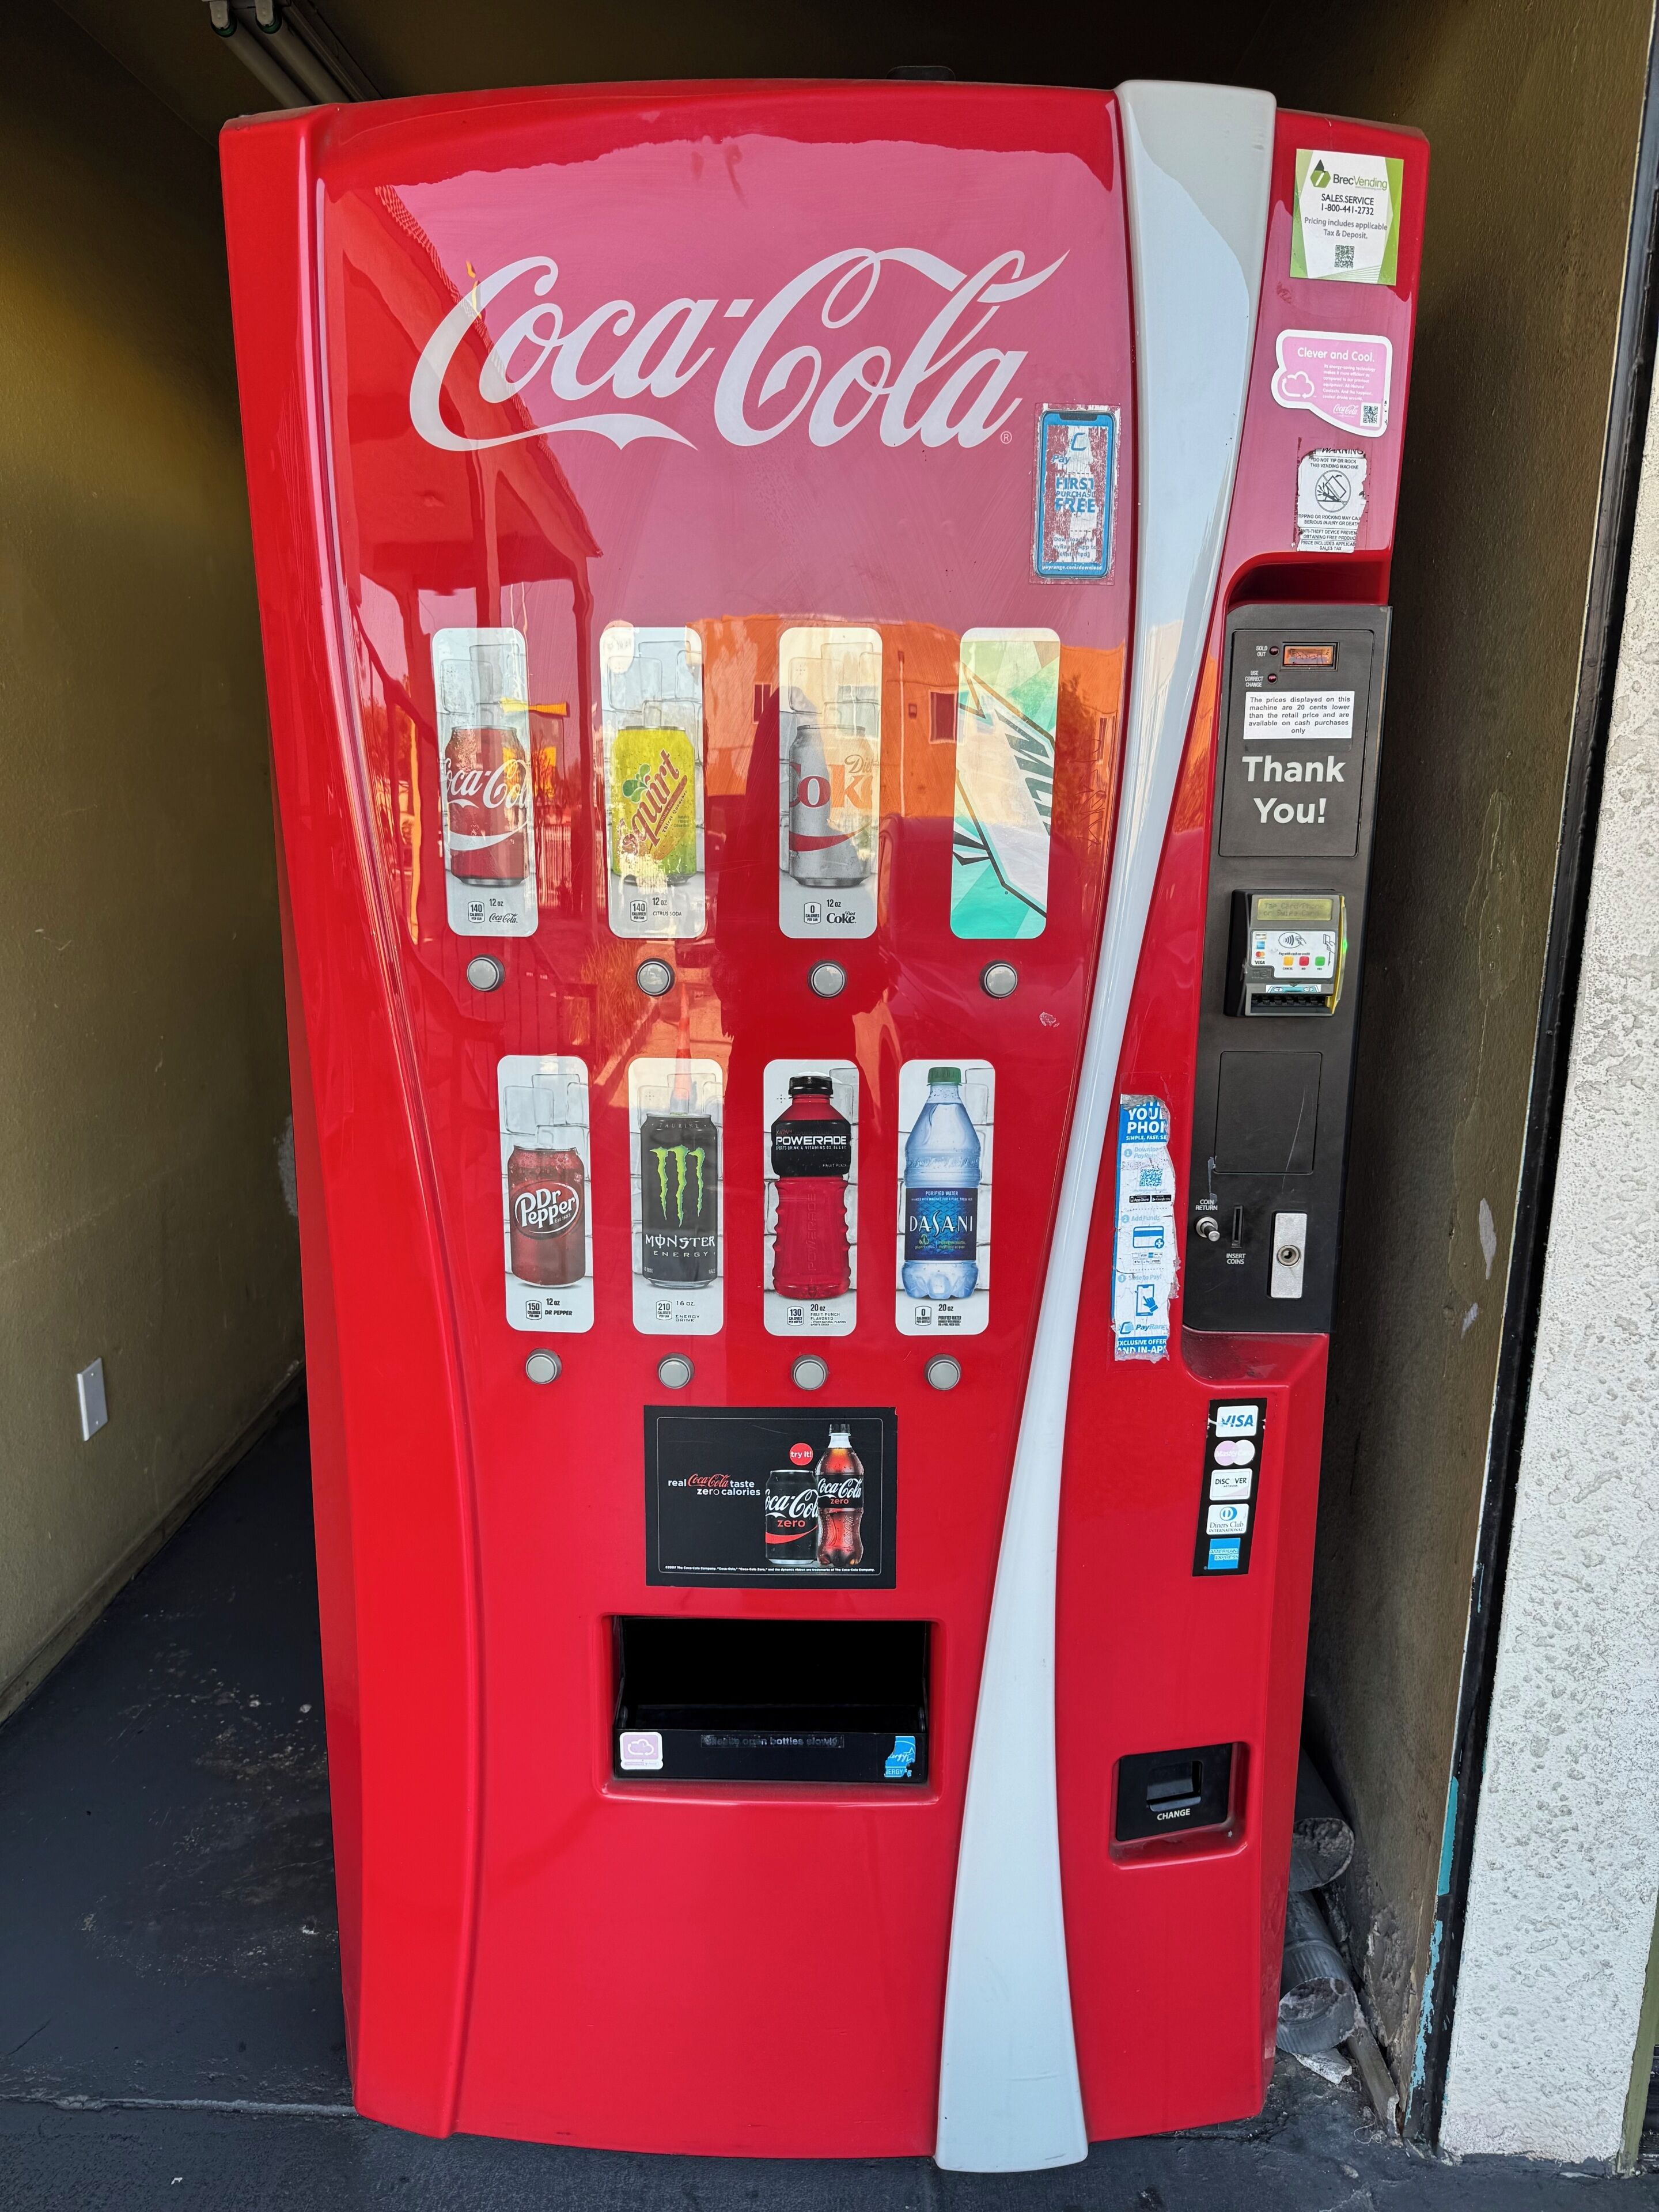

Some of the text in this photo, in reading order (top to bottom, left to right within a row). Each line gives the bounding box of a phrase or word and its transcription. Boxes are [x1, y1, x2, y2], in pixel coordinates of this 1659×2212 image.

[1333, 174, 1388, 191] BrecVending
[1321, 194, 1374, 206] SALES.SERVICE
[1321, 204, 1374, 215] 1-800-441-2732
[1304, 217, 1388, 231] Pricing includes applicable
[1342, 230, 1368, 240] Deposit.
[409, 248, 1070, 452] Coca-Cola
[1297, 347, 1375, 362] Clever and Cool.
[1055, 497, 1096, 513] FREE
[1266, 696, 1286, 704] prices
[1290, 696, 1323, 704] displayed
[1315, 719, 1349, 728] purchases
[1242, 755, 1346, 782] Thank
[1253, 798, 1327, 824] You!
[489, 899, 497, 907] 12
[652, 897, 660, 906] 12
[827, 899, 834, 907] 12
[471, 904, 482, 912] 140
[632, 903, 646, 912] 140
[810, 905, 815, 914] 0
[826, 912, 855, 923] Coke
[775, 1135, 847, 1145] POWERADE
[536, 1188, 561, 1206] Dr
[521, 1192, 575, 1228] Pepper
[910, 1209, 973, 1238] DASANI
[645, 1234, 715, 1249] MONSTER
[790, 1308, 801, 1316] 130
[921, 1308, 926, 1316] 0
[1221, 1414, 1253, 1427] VISA
[790, 1450, 802, 1459] try
[668, 1473, 755, 1488] real Coca-Cola taste
[721, 1487, 760, 1496] calories
[777, 1519, 806, 1528] zero
[770, 1737, 804, 1745] bottles
[1157, 1808, 1190, 1821] CHANGE
